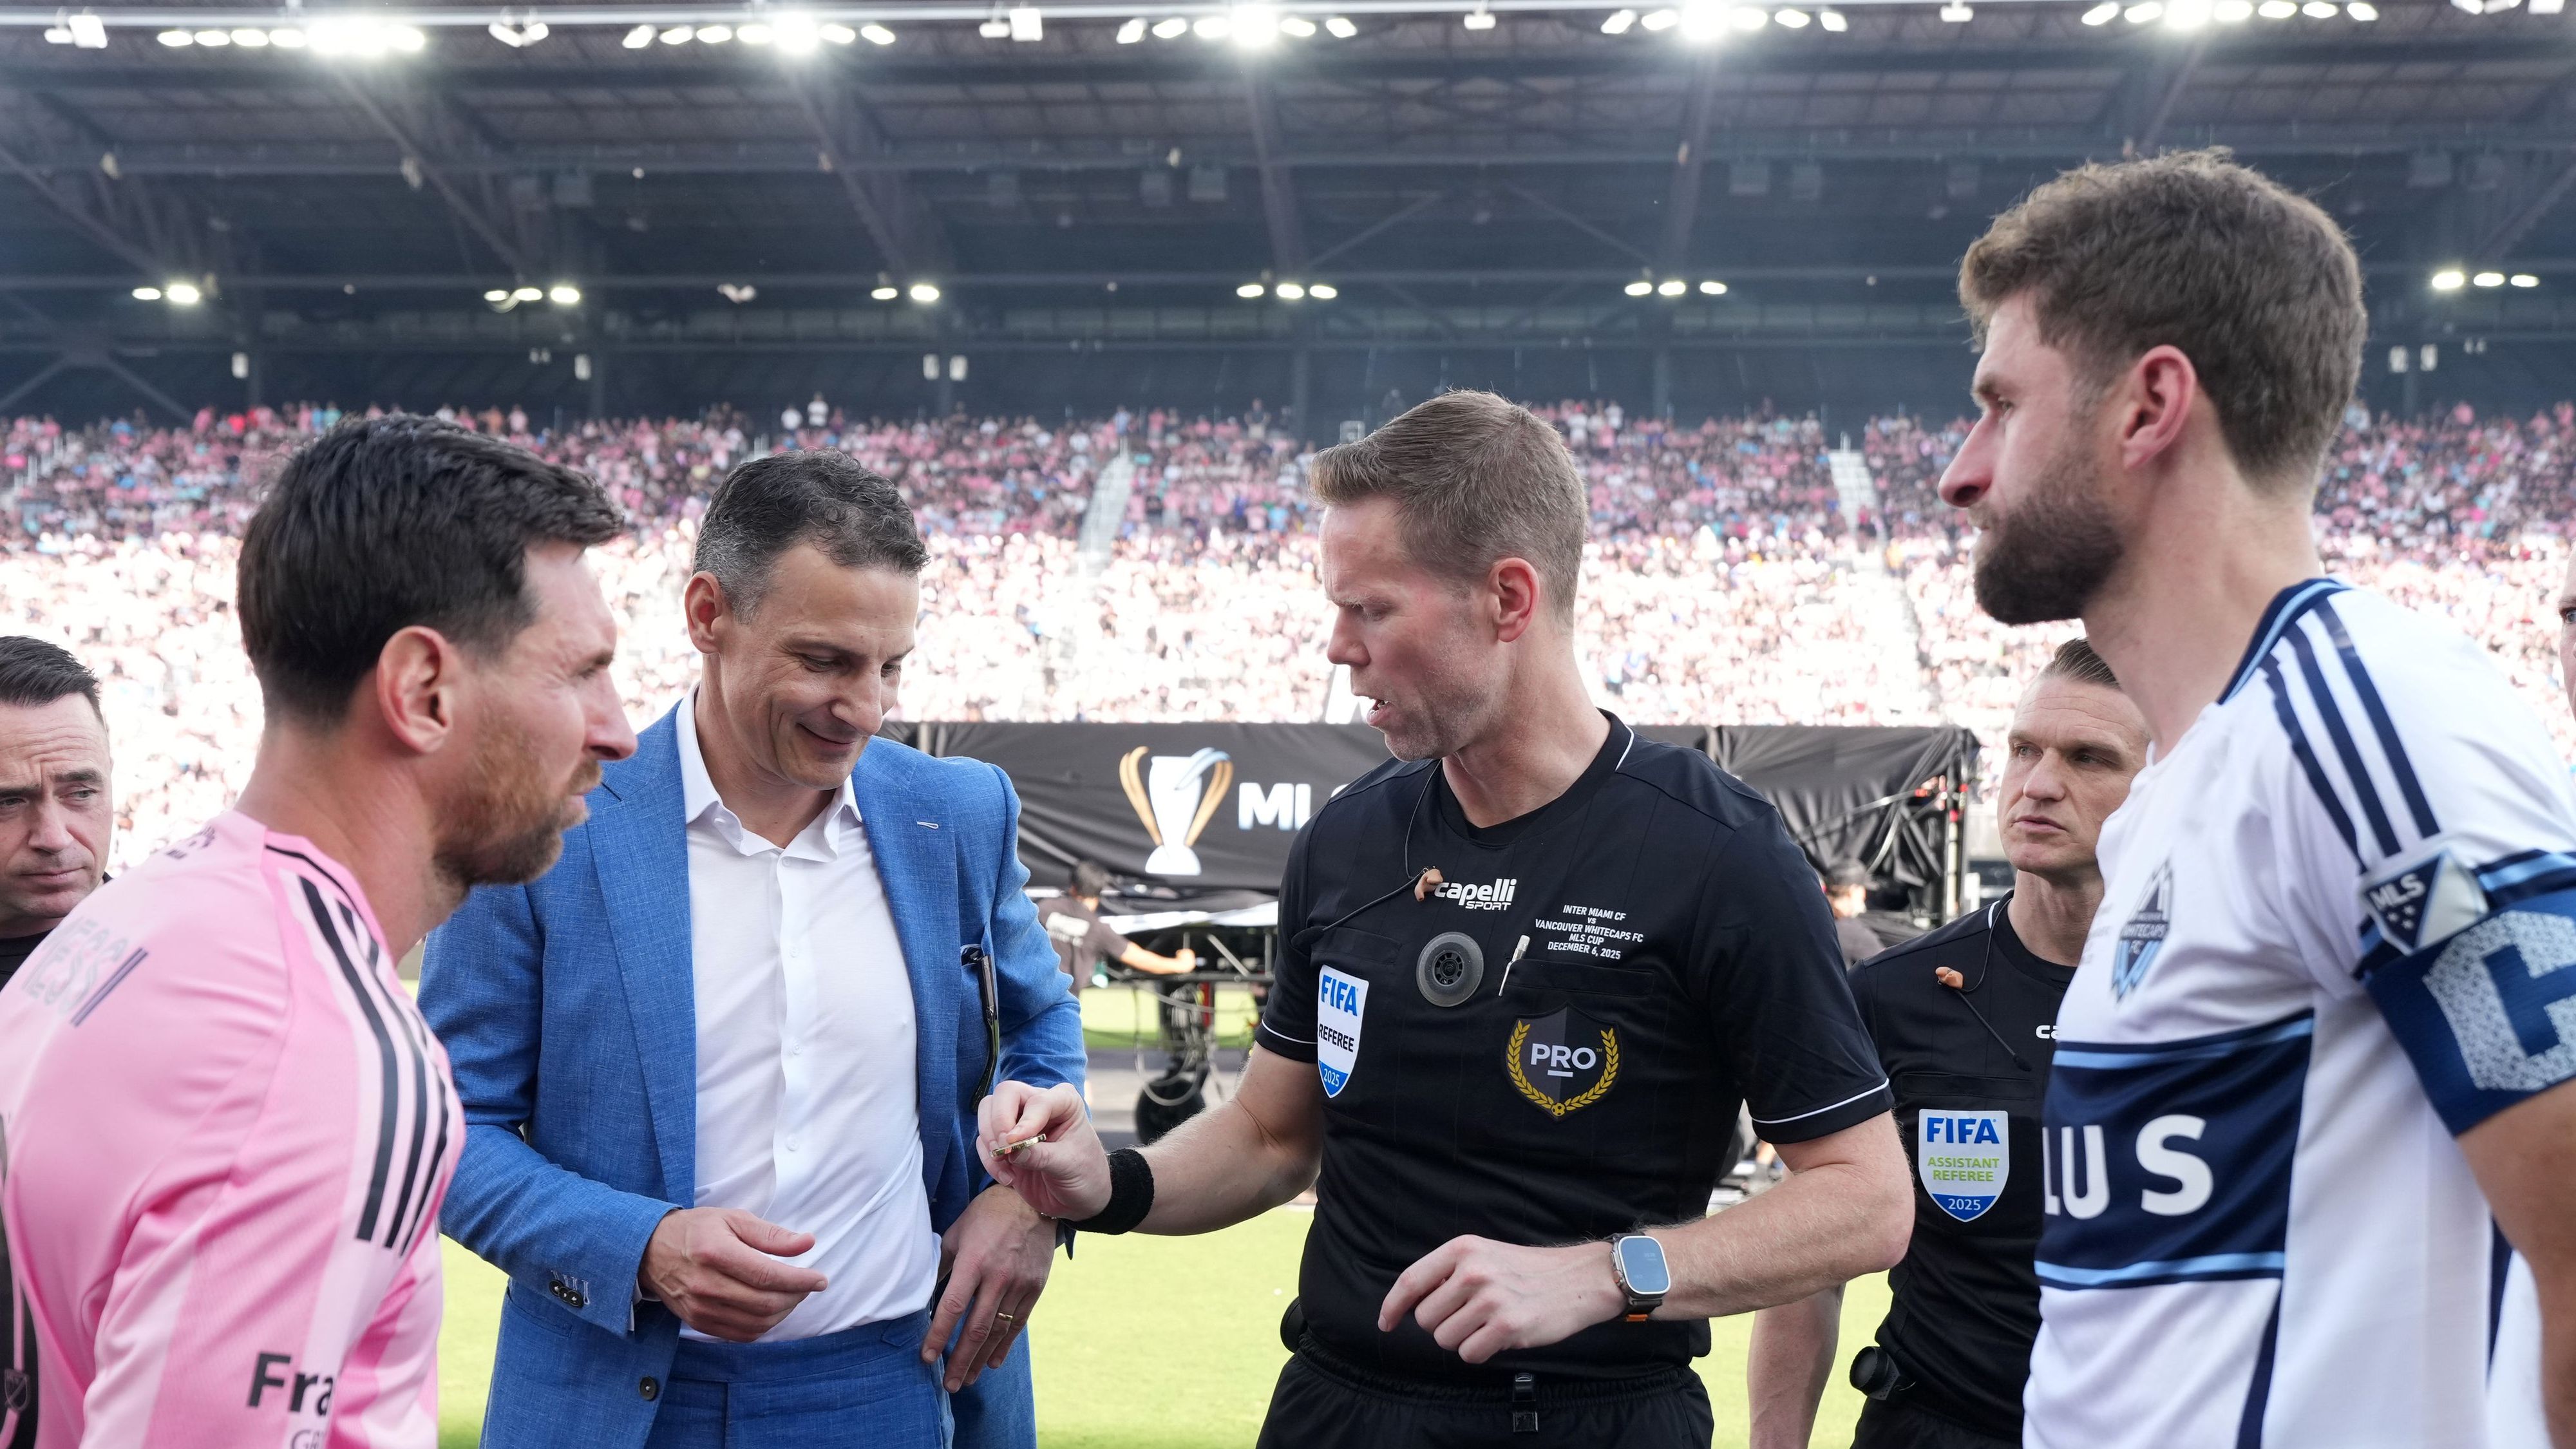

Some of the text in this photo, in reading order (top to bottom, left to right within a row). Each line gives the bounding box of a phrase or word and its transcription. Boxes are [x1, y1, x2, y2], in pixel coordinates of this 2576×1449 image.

[1238, 782, 1349, 831] ML
[1434, 878, 1517, 906] capelli
[2369, 874, 2426, 910] MLS
[1465, 901, 1511, 911] SPORT
[1563, 905, 1626, 921] INTER MIAMI CF
[1535, 918, 1643, 942] VANCOUVER WHITECAPS FC
[1569, 933, 1604, 945] MLS CUP
[1548, 941, 1621, 960] DECEMBER 6, 2025
[1321, 974, 1358, 1016] FIFA
[1319, 1023, 1354, 1052] REFEREE
[1531, 1043, 1596, 1070] PRO
[1323, 1068, 1340, 1087] 2025
[1927, 1117, 2000, 1144] FIFA
[1927, 1157, 2000, 1168] ASSISTANT
[1933, 1170, 1994, 1182] REFEREE
[1948, 1198, 1981, 1211] 2025
[248, 1353, 334, 1416] Fra
